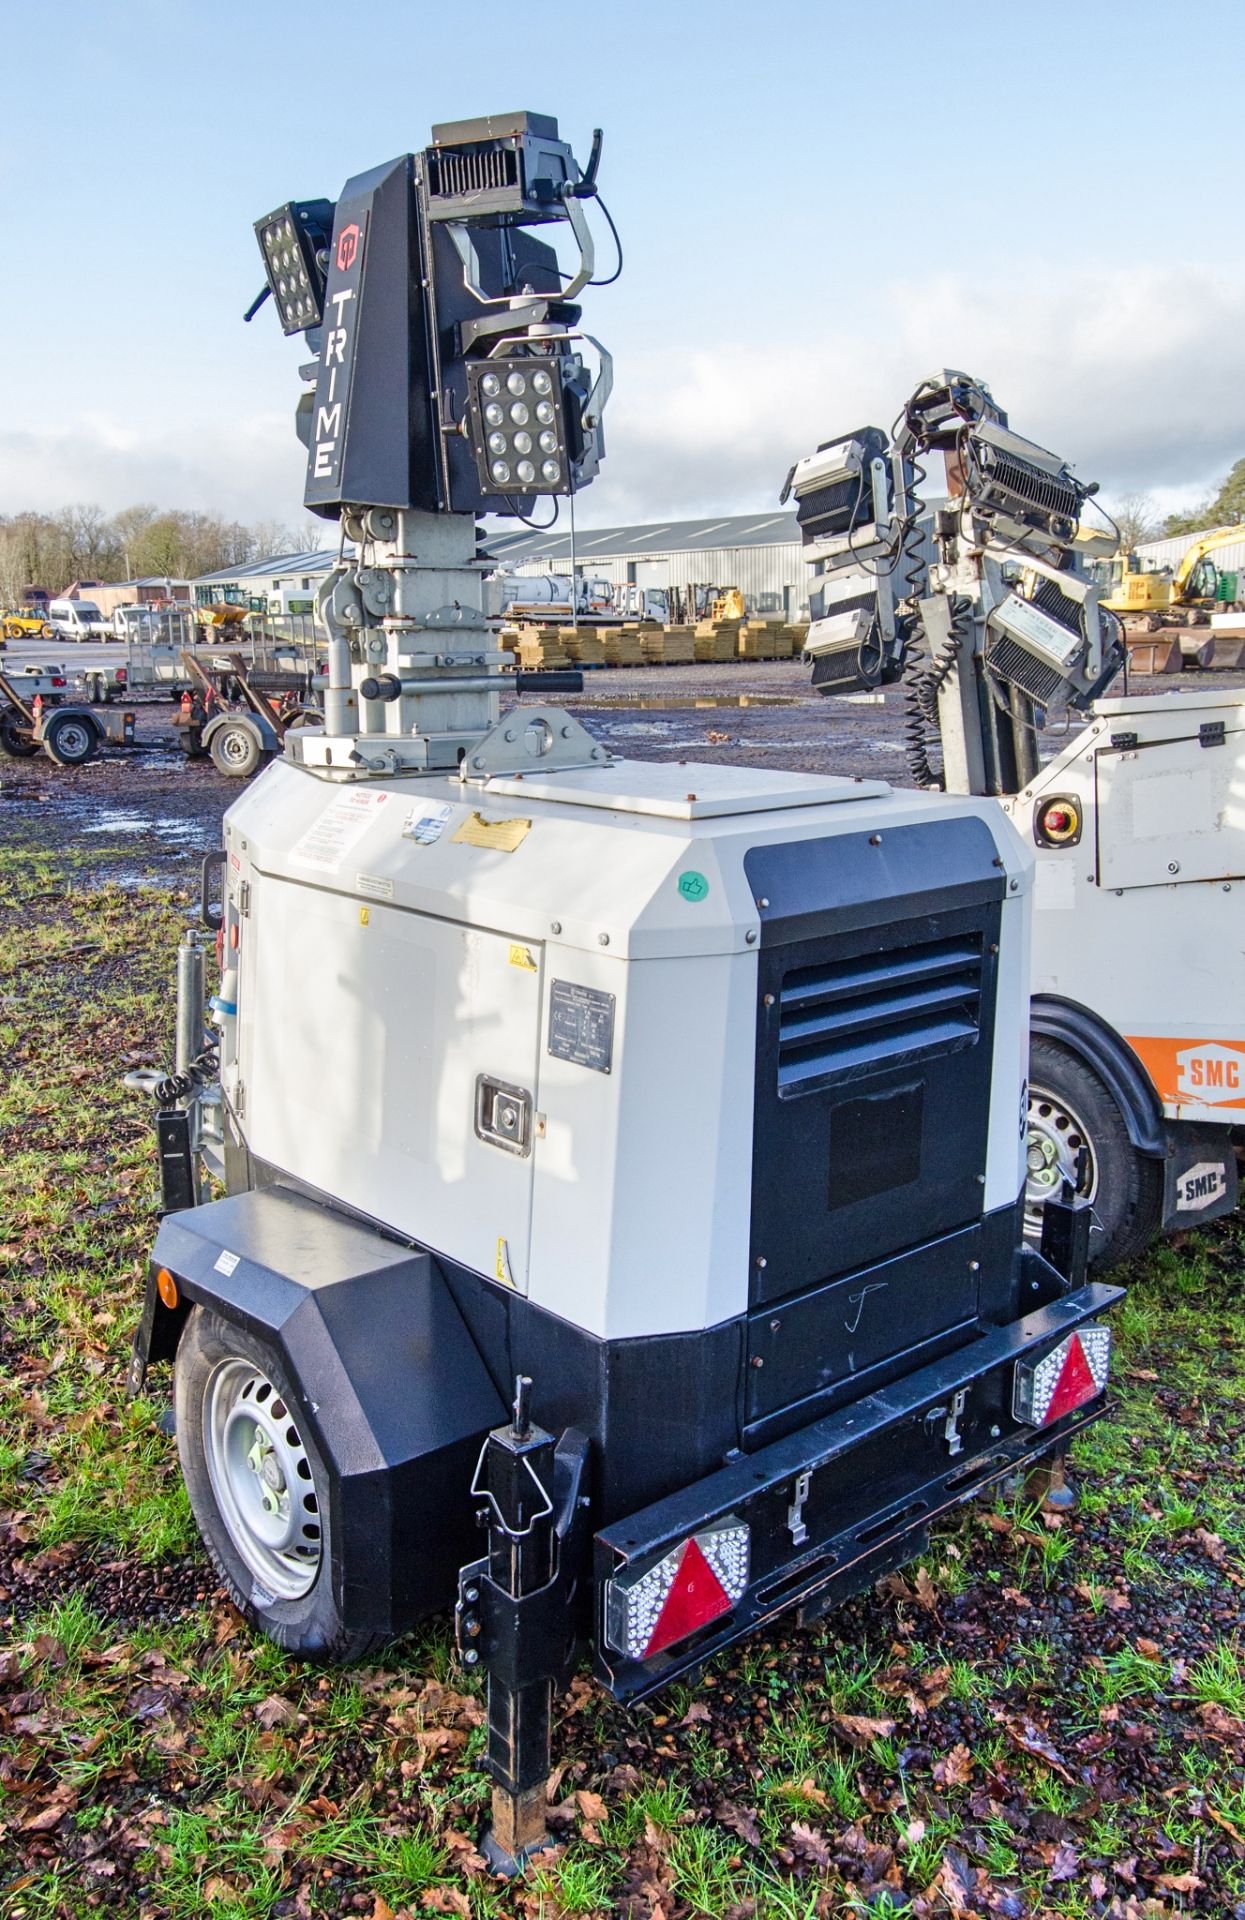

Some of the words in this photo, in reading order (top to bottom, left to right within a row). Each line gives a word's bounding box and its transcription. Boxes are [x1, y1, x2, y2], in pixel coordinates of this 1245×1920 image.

[313, 289, 353, 478] TRIME
[1190, 1058, 1240, 1089] SMC
[1185, 1171, 1218, 1202] SMC
